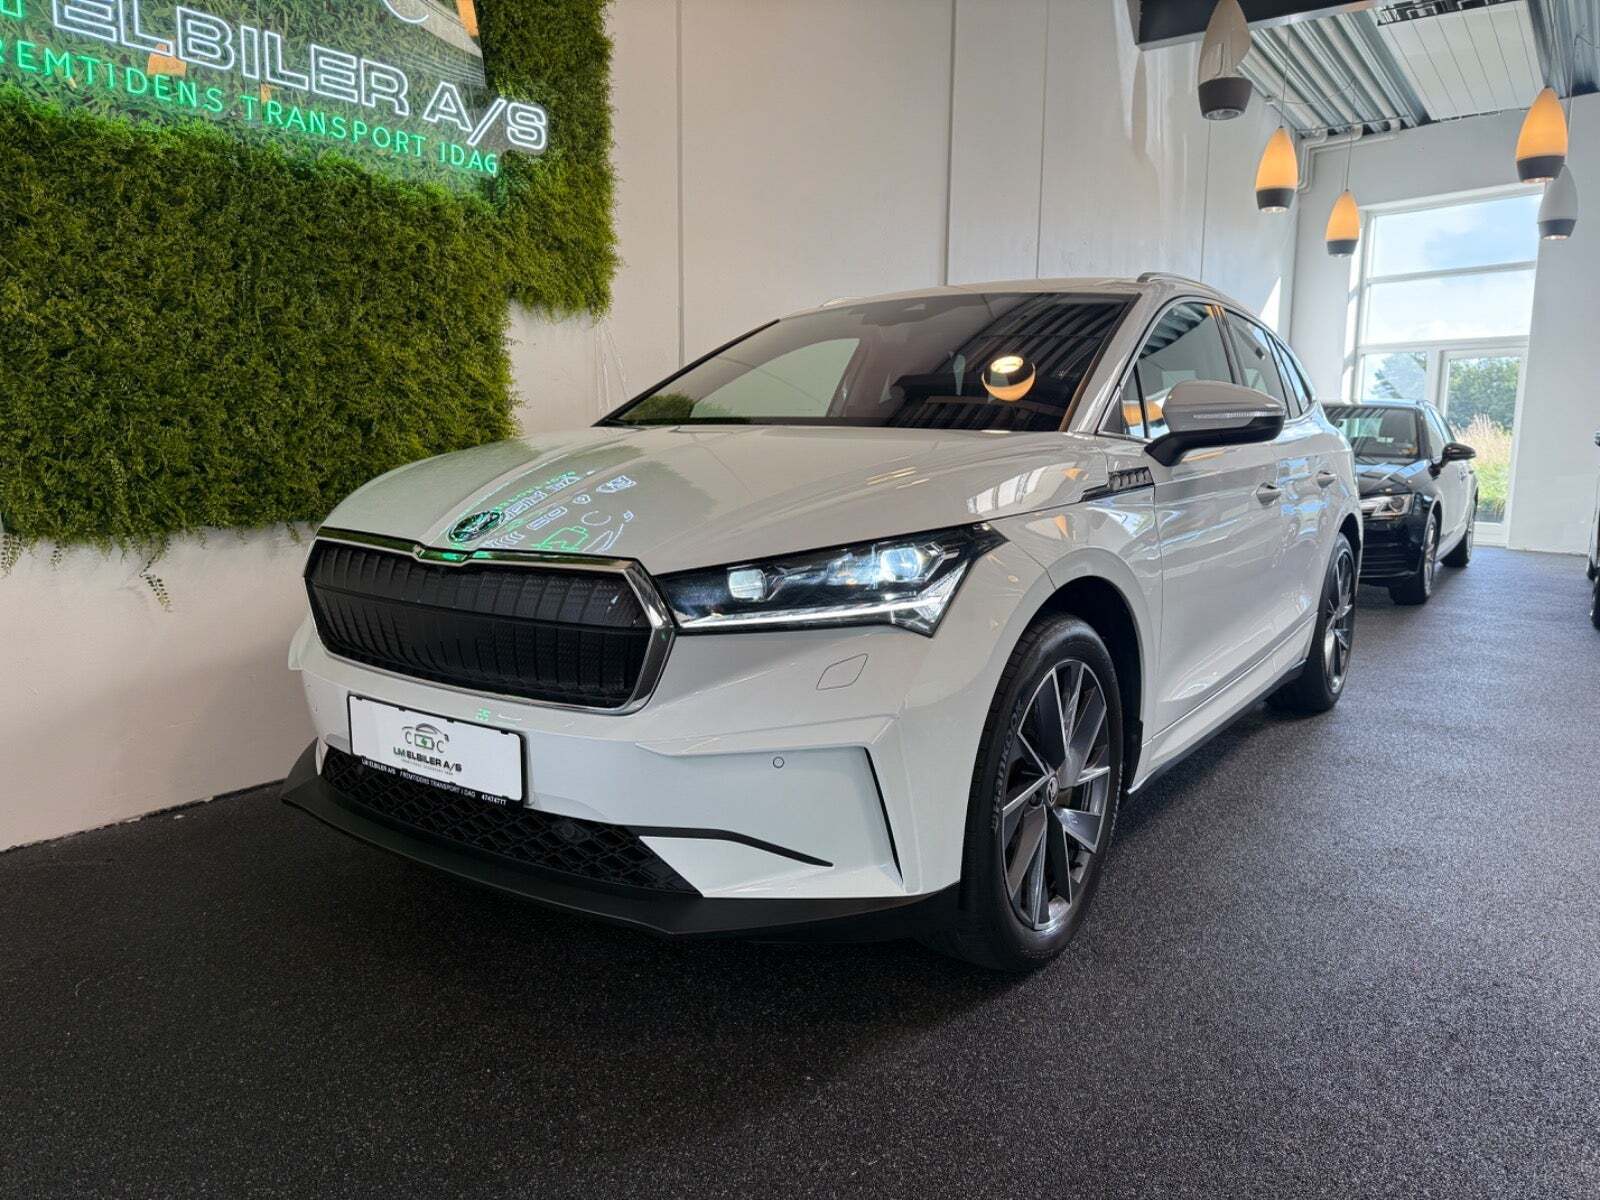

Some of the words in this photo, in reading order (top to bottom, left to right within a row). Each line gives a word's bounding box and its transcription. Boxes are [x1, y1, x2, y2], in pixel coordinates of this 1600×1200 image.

[0, 39, 224, 113] EMTIDENS
[239, 94, 427, 158] TRANSPORT
[439, 141, 498, 178] IDAG
[53, 0, 410, 117] ELBILER
[422, 80, 548, 151] A/S
[406, 750, 442, 768] ELBILER
[443, 760, 463, 773] A/S
